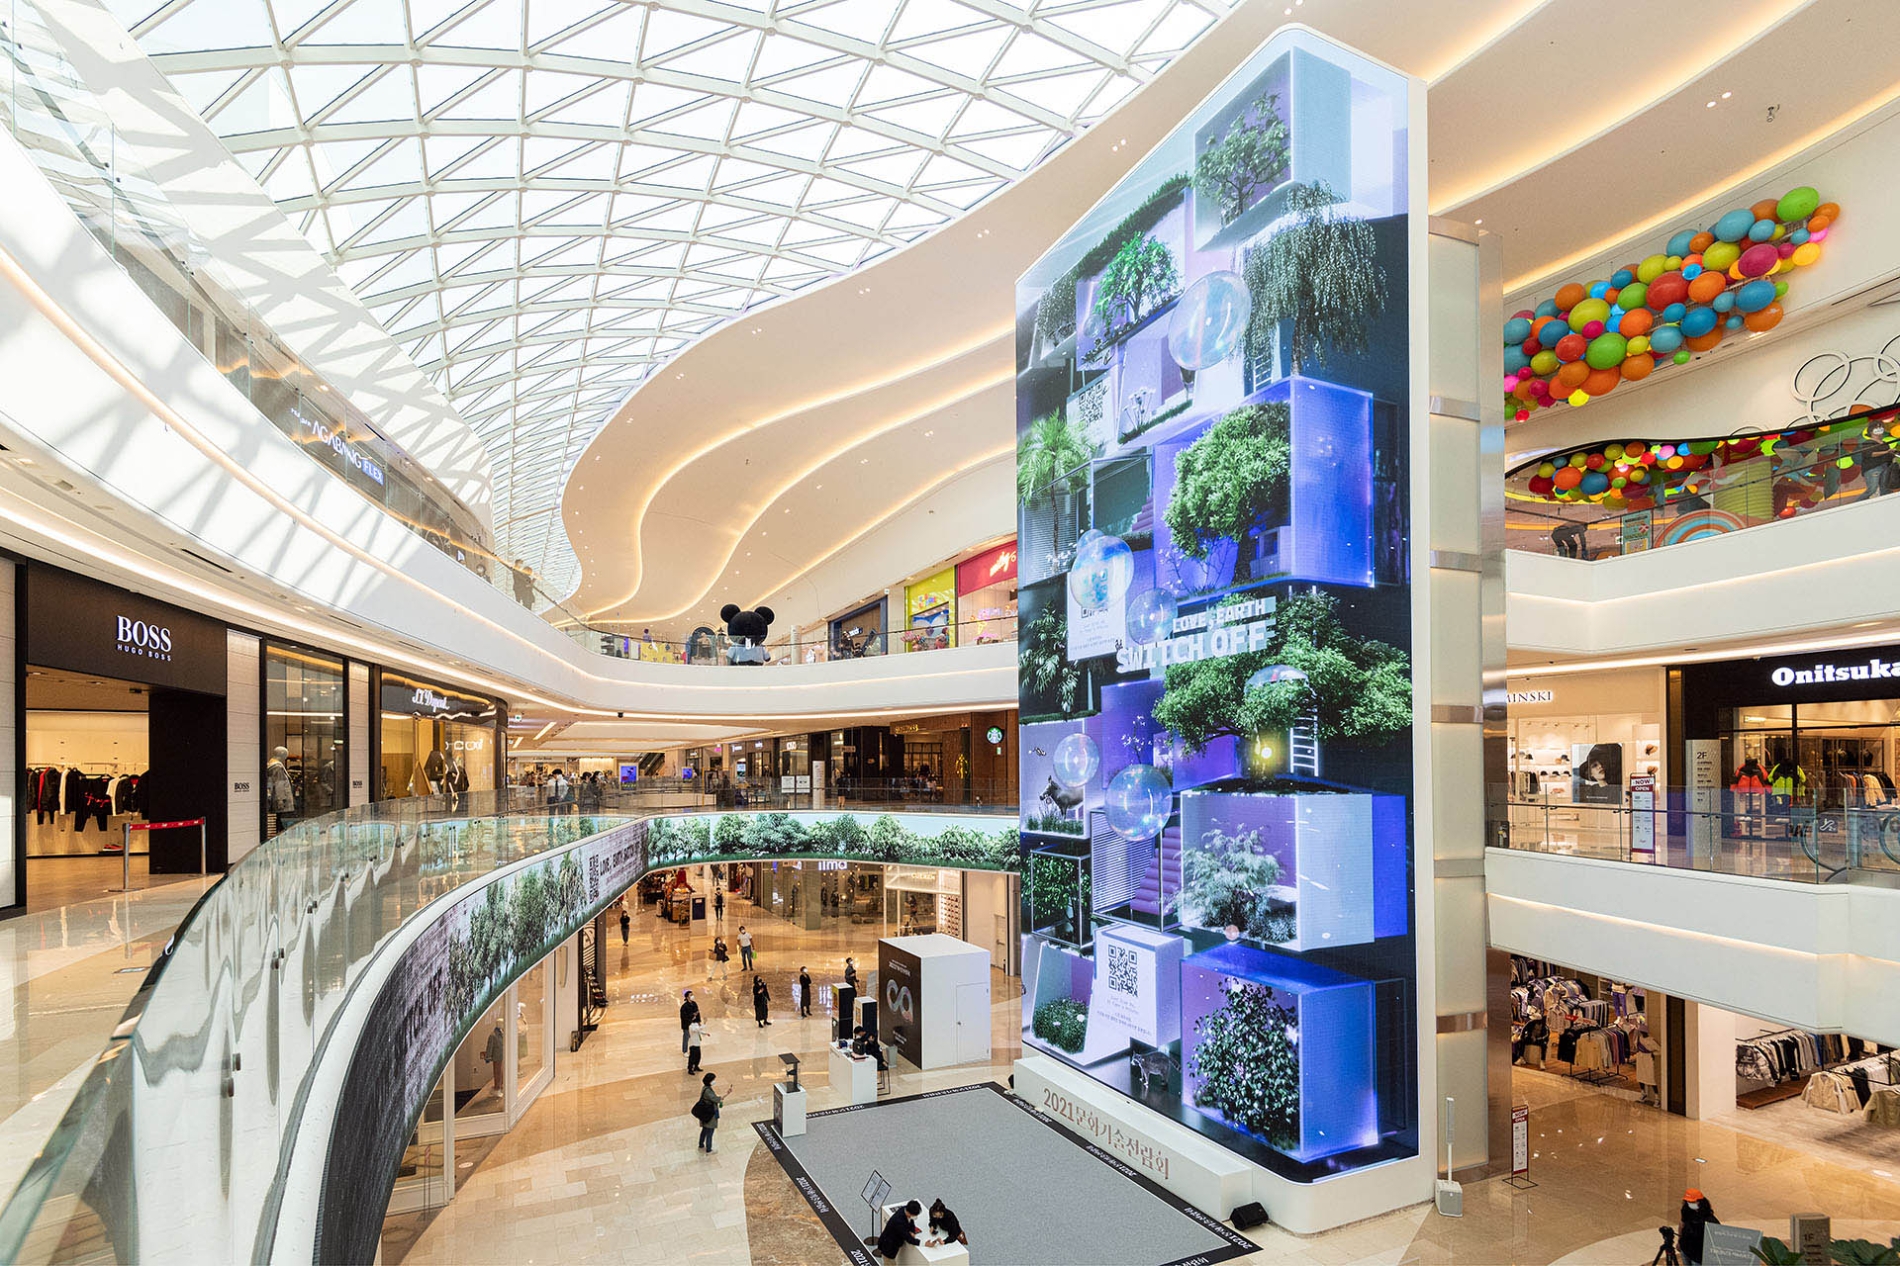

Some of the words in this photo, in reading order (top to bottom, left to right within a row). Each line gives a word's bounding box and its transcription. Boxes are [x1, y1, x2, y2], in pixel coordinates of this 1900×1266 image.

[363, 460, 383, 481] FLEX
[1216, 597, 1266, 626] EARTH
[116, 614, 172, 653] BOSS
[116, 643, 143, 656] HUGO
[147, 650, 171, 662] BOSS
[1116, 634, 1204, 674] SWITCH
[1210, 619, 1268, 658] OFF
[234, 782, 250, 790] BOSS
[1634, 778, 1651, 786] NOW
